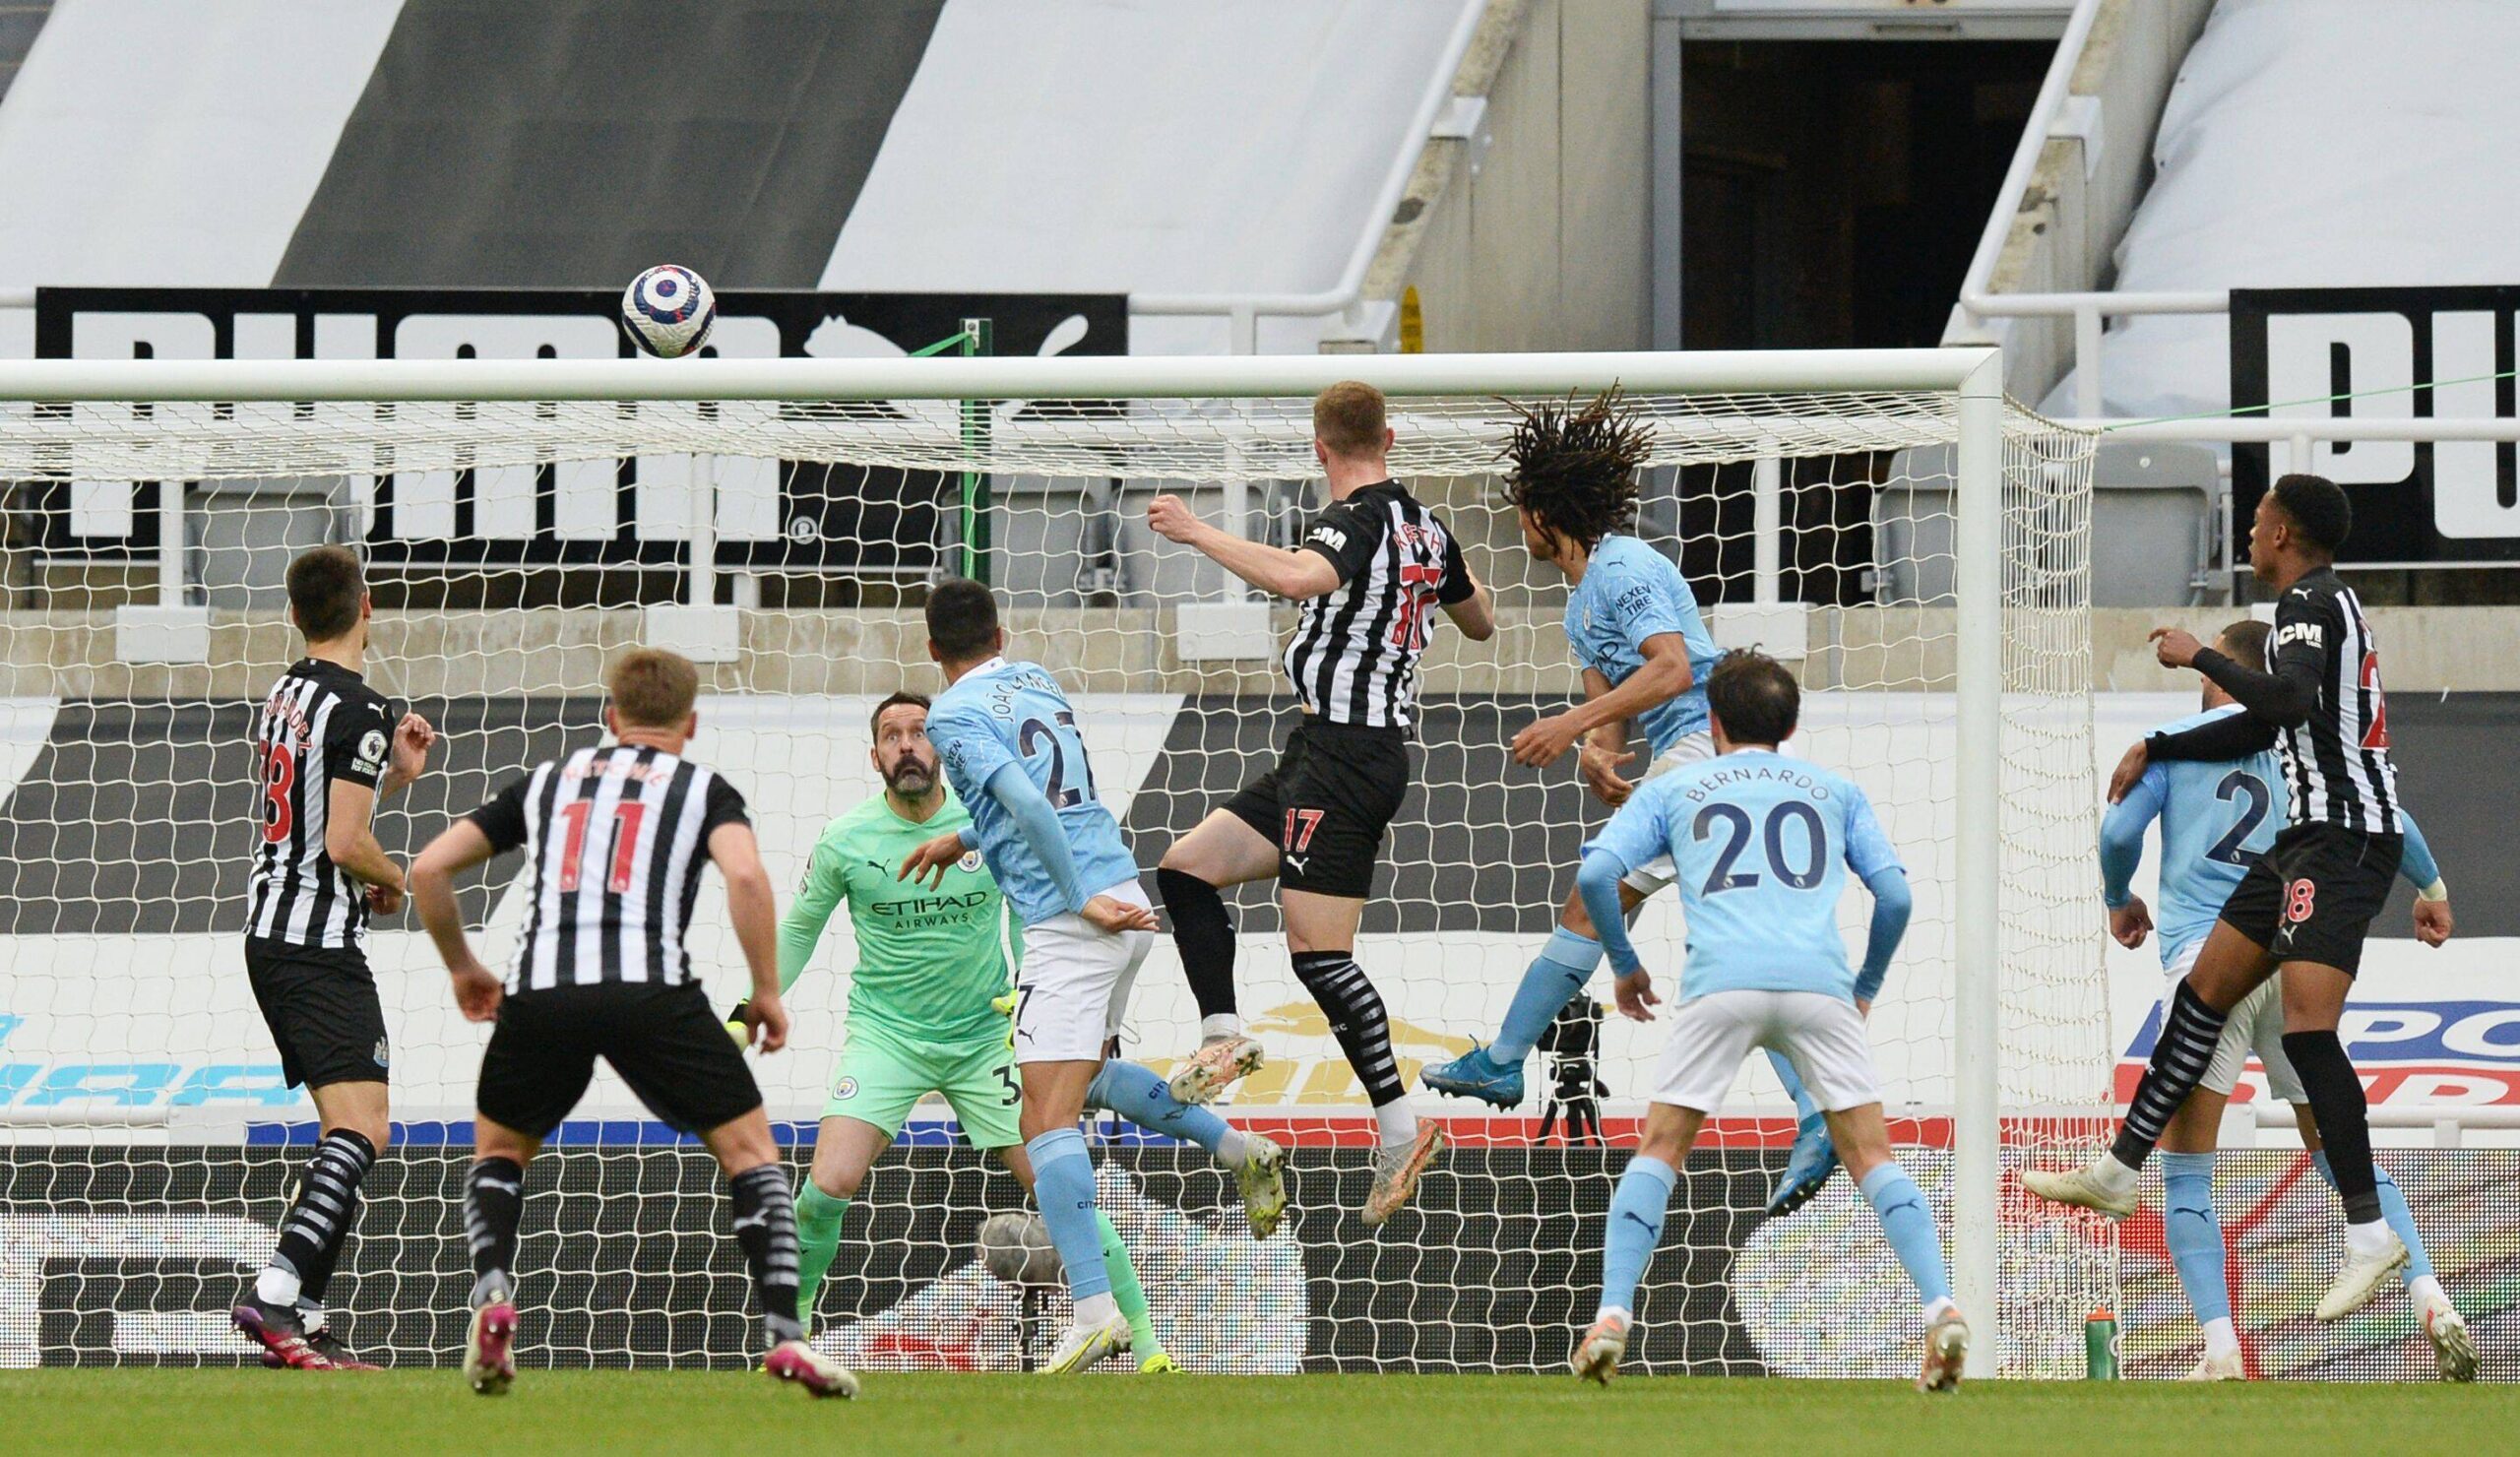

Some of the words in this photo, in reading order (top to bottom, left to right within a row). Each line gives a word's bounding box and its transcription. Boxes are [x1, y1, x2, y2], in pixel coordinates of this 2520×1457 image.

[1625, 596, 1654, 615] TIRE
[1686, 767, 1829, 803] BERNARDO
[1284, 807, 1325, 853] 17
[2204, 767, 2271, 870] 2
[559, 798, 647, 893] 11
[1692, 800, 1828, 898] 20
[871, 891, 986, 916] ETIHAD
[895, 912, 970, 929] AIRWAYS
[992, 1063, 1022, 1107] 3
